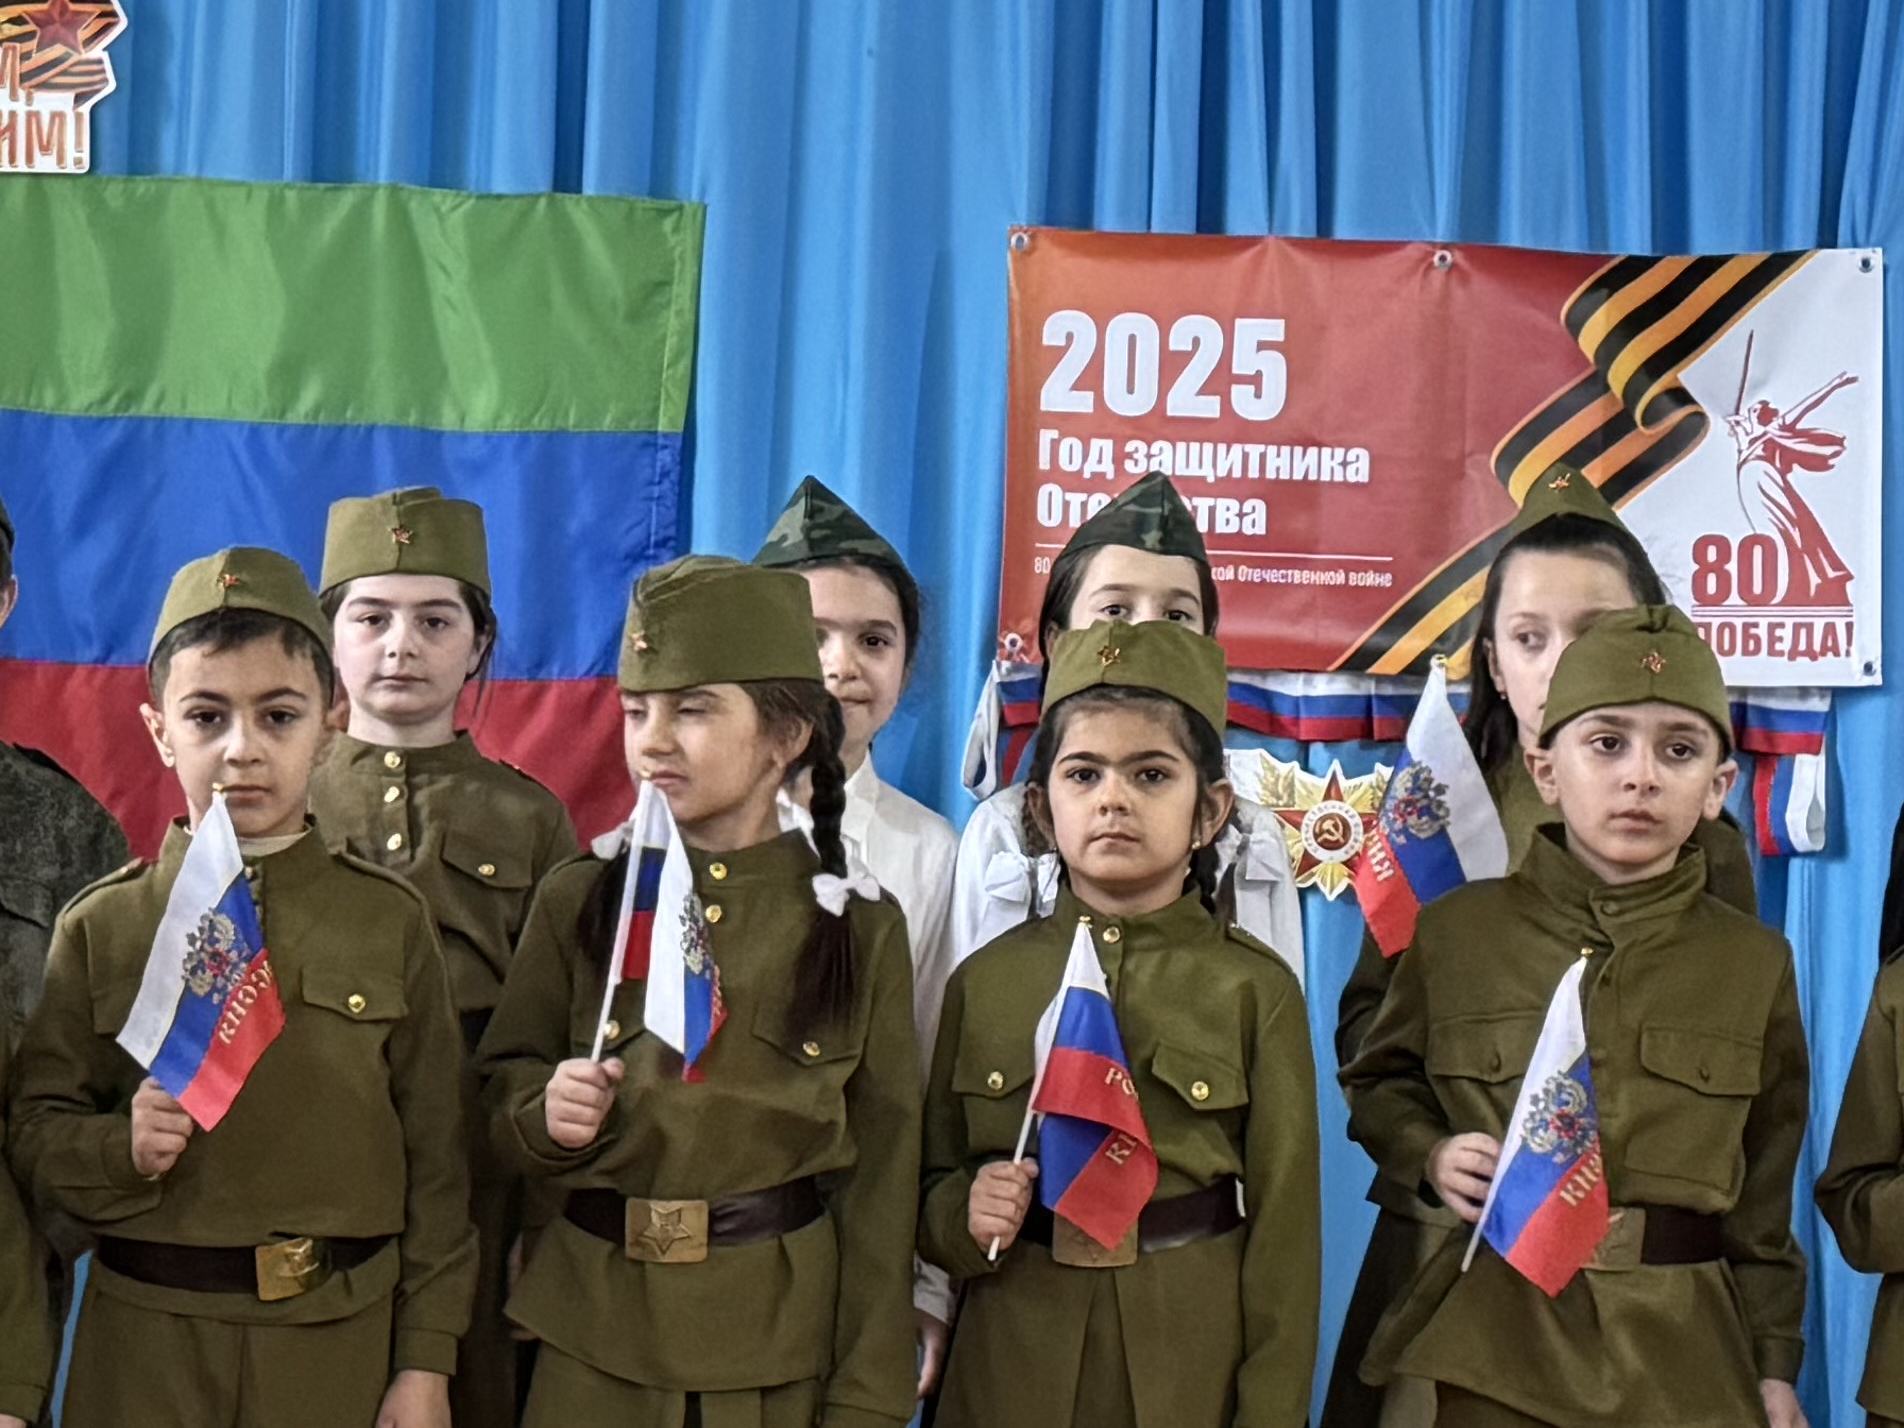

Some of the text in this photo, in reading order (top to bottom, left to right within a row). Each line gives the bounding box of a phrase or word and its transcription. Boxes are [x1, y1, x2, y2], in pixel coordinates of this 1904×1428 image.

[1040, 310, 1287, 421] 2025
[1038, 429, 1369, 483] Год защитника
[1348, 570, 1392, 588] войне
[1691, 534, 1778, 605] 80
